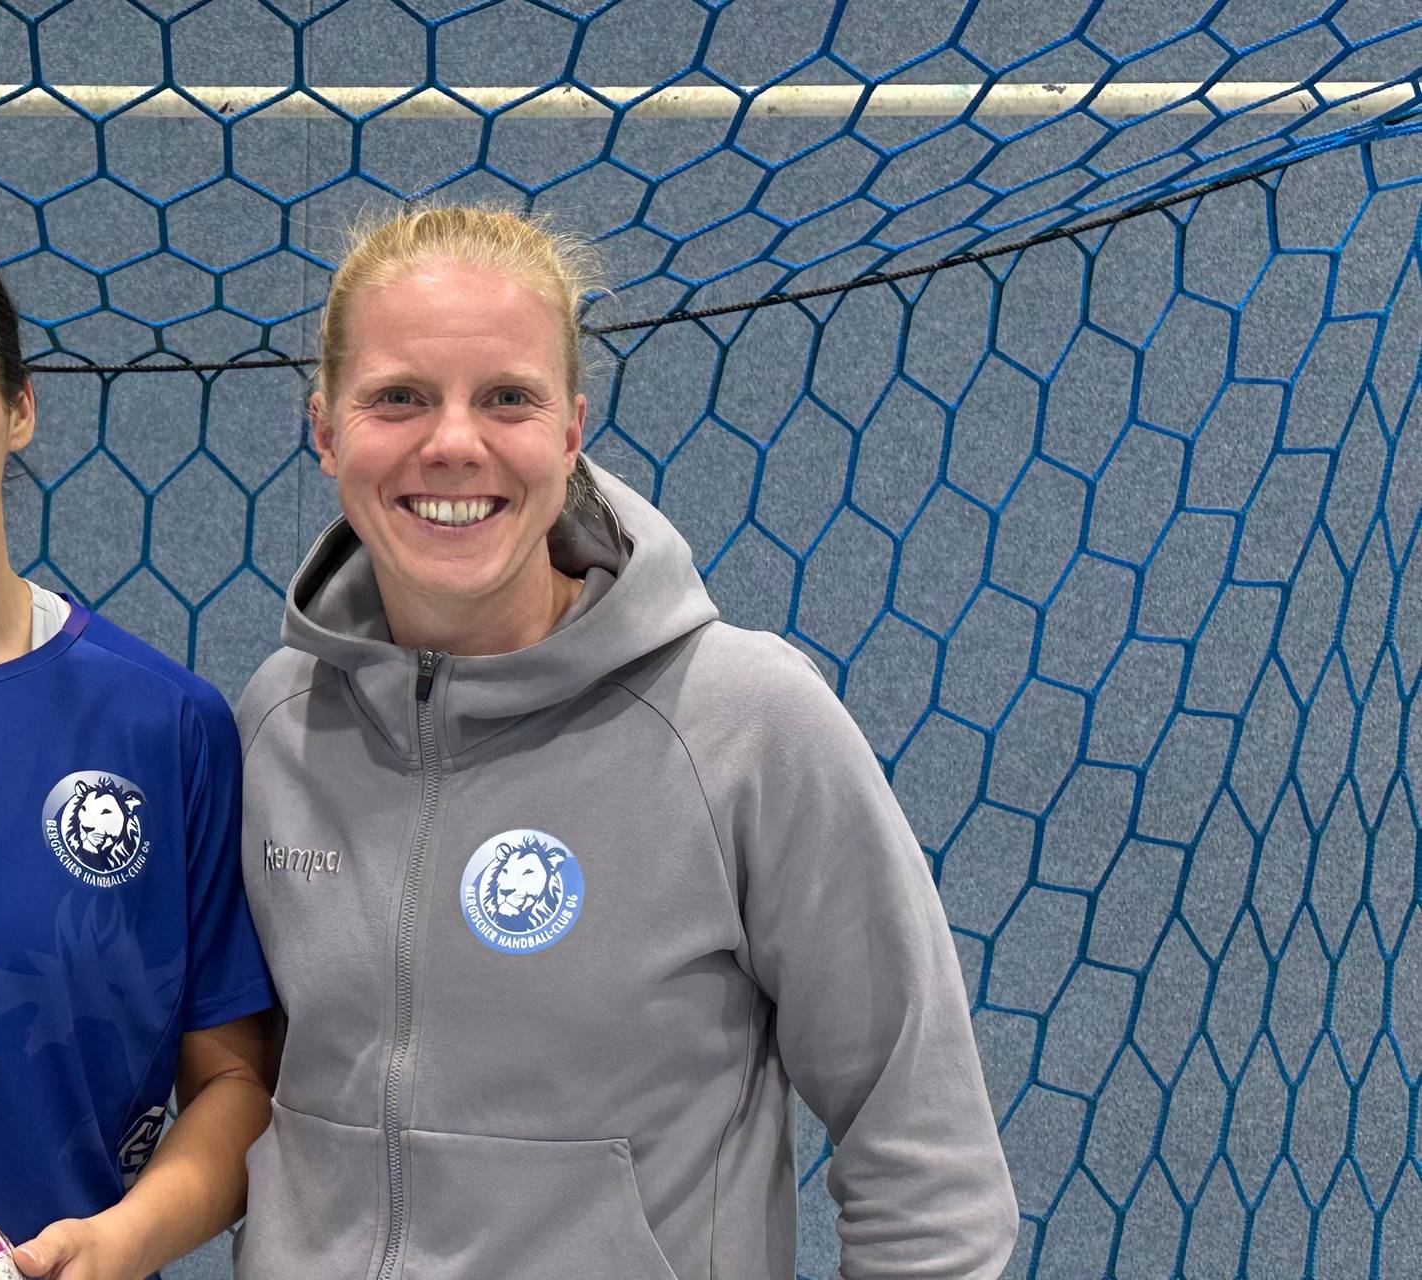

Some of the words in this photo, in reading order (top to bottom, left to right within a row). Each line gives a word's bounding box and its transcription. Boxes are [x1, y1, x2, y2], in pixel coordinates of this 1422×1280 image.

[45, 819, 83, 877] BERGISCHER
[263, 839, 343, 881] Kempa
[465, 885, 499, 942] BERGISCHER
[565, 894, 579, 909] 06
